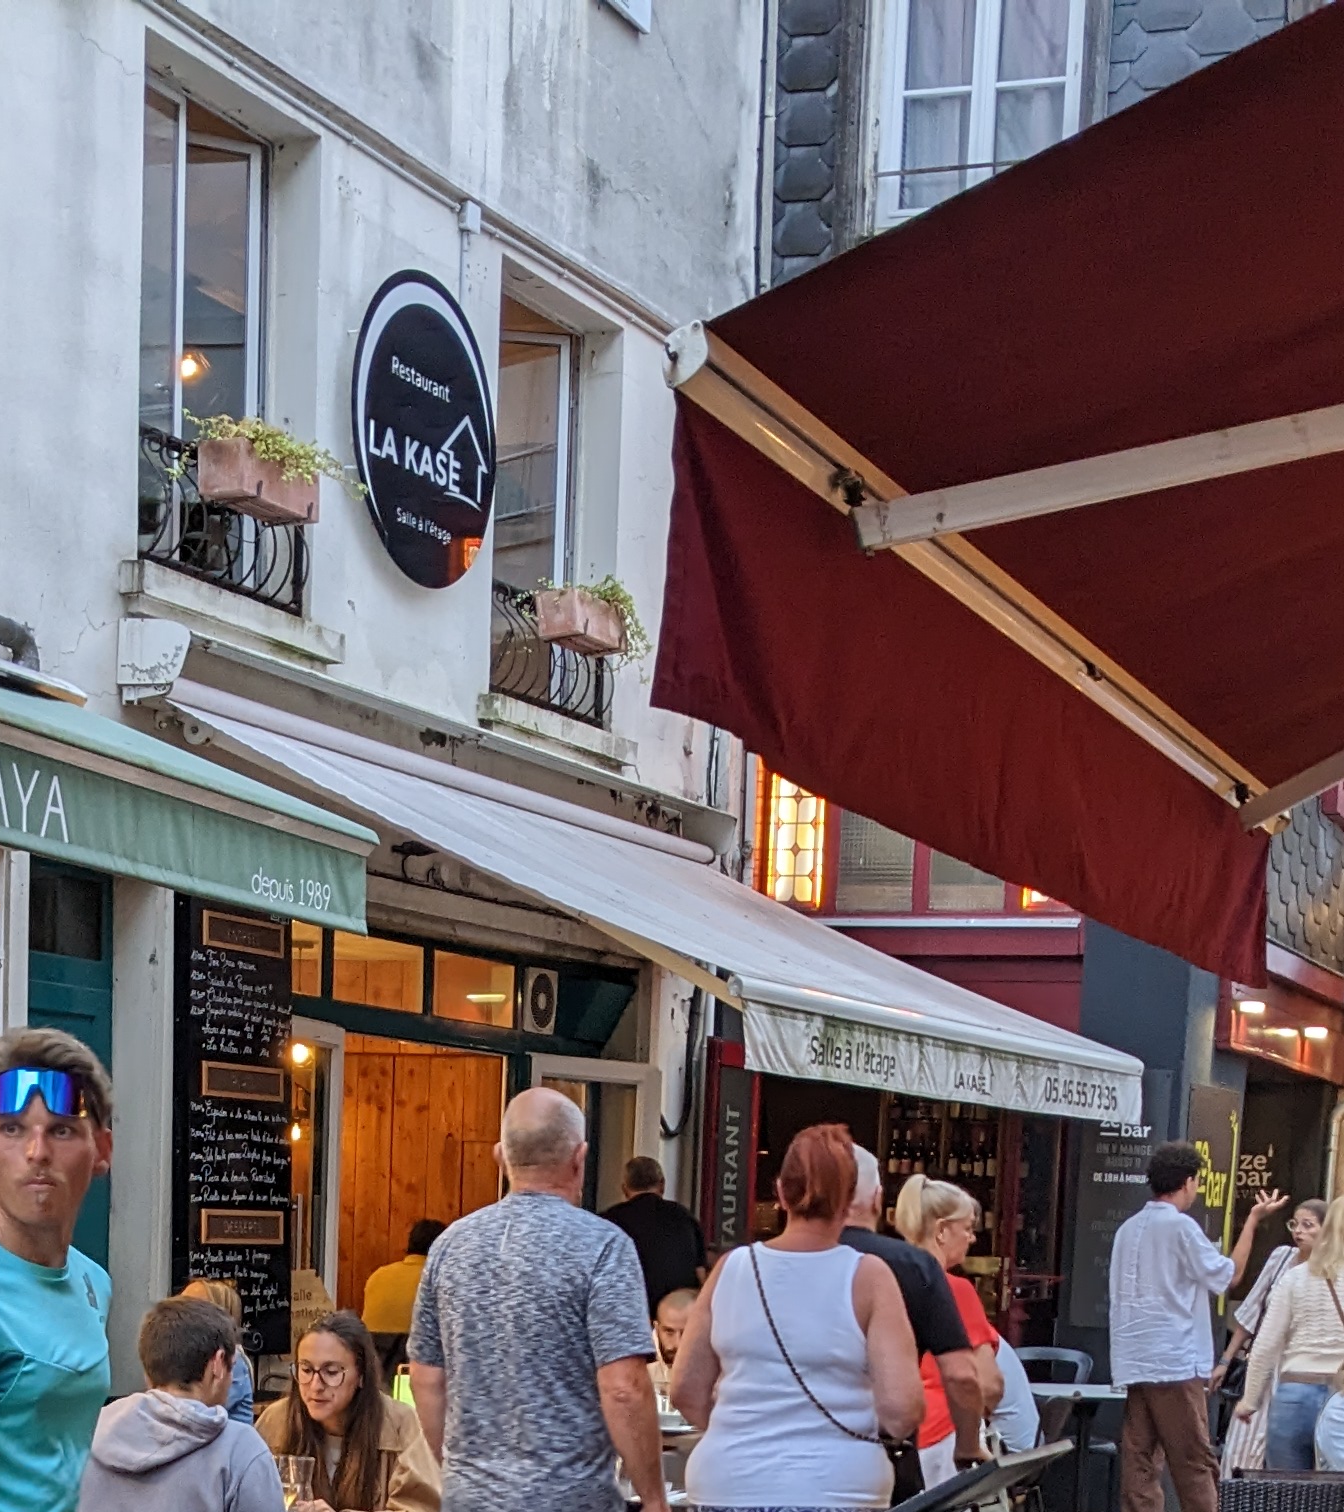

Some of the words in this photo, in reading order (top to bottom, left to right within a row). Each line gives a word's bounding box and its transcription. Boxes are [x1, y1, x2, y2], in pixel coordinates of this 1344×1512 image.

[391, 355, 452, 403] Restaurant
[369, 419, 398, 465] LA
[397, 507, 416, 527] Salle
[252, 869, 295, 907] depuis
[298, 877, 332, 912] 1989
[810, 1035, 842, 1069] Salle
[844, 1042, 852, 1071] à
[856, 1046, 896, 1083] l'étage
[954, 1071, 966, 1091] LA
[1120, 1121, 1152, 1138] bar
[1240, 1154, 1268, 1170] ze
[1205, 1159, 1227, 1208] bar
[291, 1288, 312, 1302] alle
